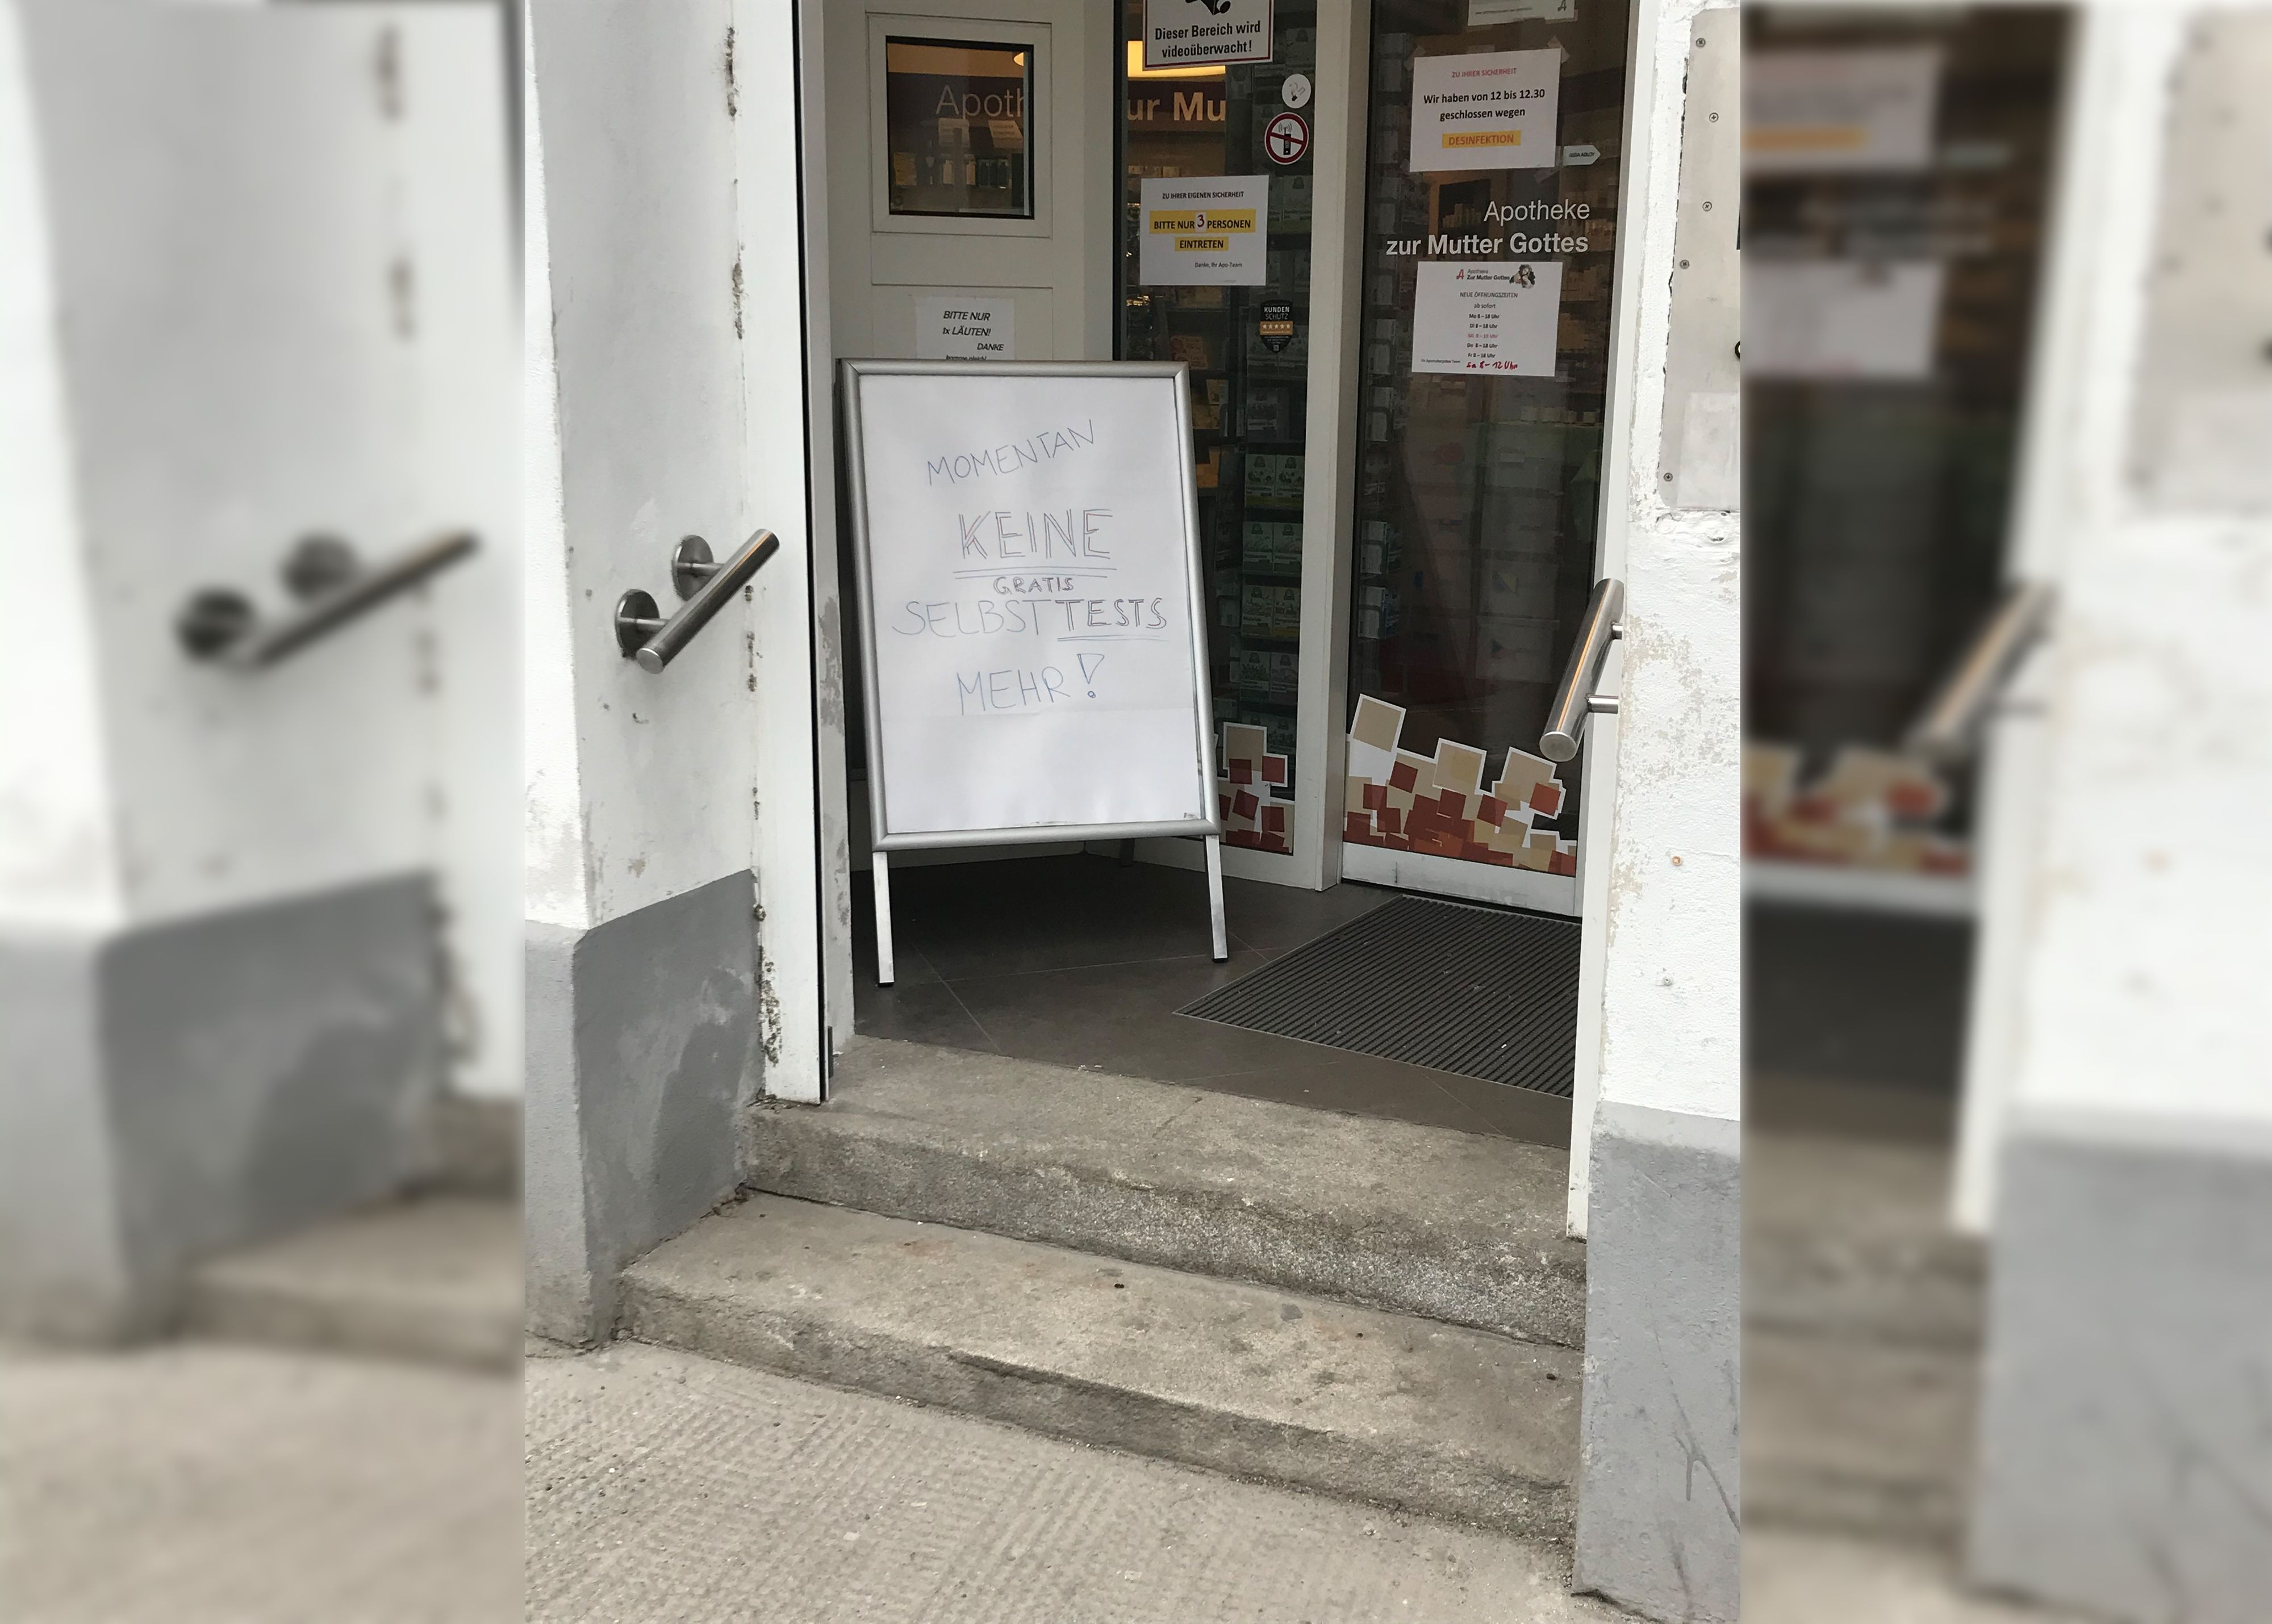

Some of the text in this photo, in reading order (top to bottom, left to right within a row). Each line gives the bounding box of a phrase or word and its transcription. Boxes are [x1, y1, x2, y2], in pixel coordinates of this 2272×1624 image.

[1155, 20, 1260, 40] Dieser Bereich wird
[1162, 41, 1252, 58] videoüberwacht!
[1481, 68, 1517, 77] SICHERHEIT
[1423, 89, 1545, 104] Wir haben von 12 bis 12.30
[1439, 108, 1525, 122] geschlossen wegen
[1449, 134, 1514, 146] DESINFEKTION
[1484, 199, 1590, 226] Apotheke
[1154, 214, 1251, 229] BITTE NUR 3 PERSONEN
[1180, 240, 1223, 249] EINTRETEN
[1386, 232, 1589, 255] zur Mutter Gottes
[943, 311, 991, 321] BITTE NUR
[952, 325, 991, 336] LÄUTEN!
[1504, 361, 1518, 370] Uhr
[927, 419, 1094, 485] MOMENTAN
[959, 509, 1113, 559] KEINE
[993, 576, 1074, 594] GRATIS
